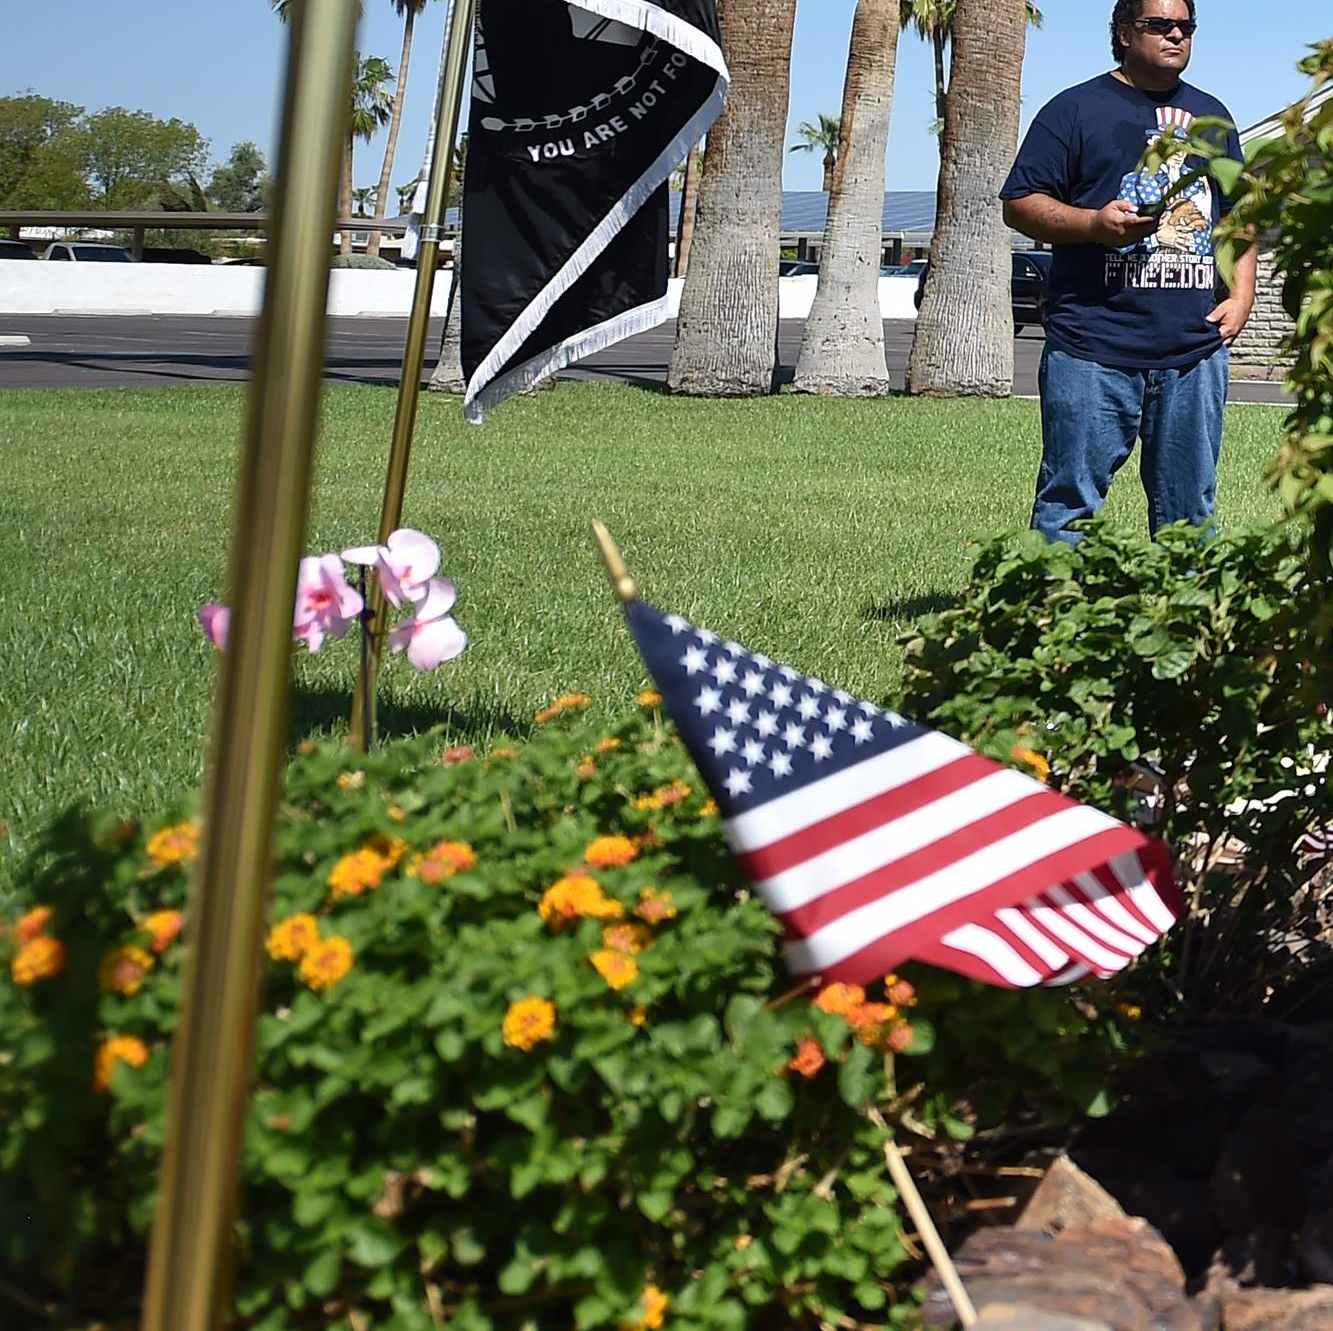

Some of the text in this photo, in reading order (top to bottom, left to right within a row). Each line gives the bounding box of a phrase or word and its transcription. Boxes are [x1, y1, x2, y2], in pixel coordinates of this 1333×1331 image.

[527, 138, 576, 163] YOU
[583, 115, 629, 149] ARE
[628, 79, 667, 120] NOT
